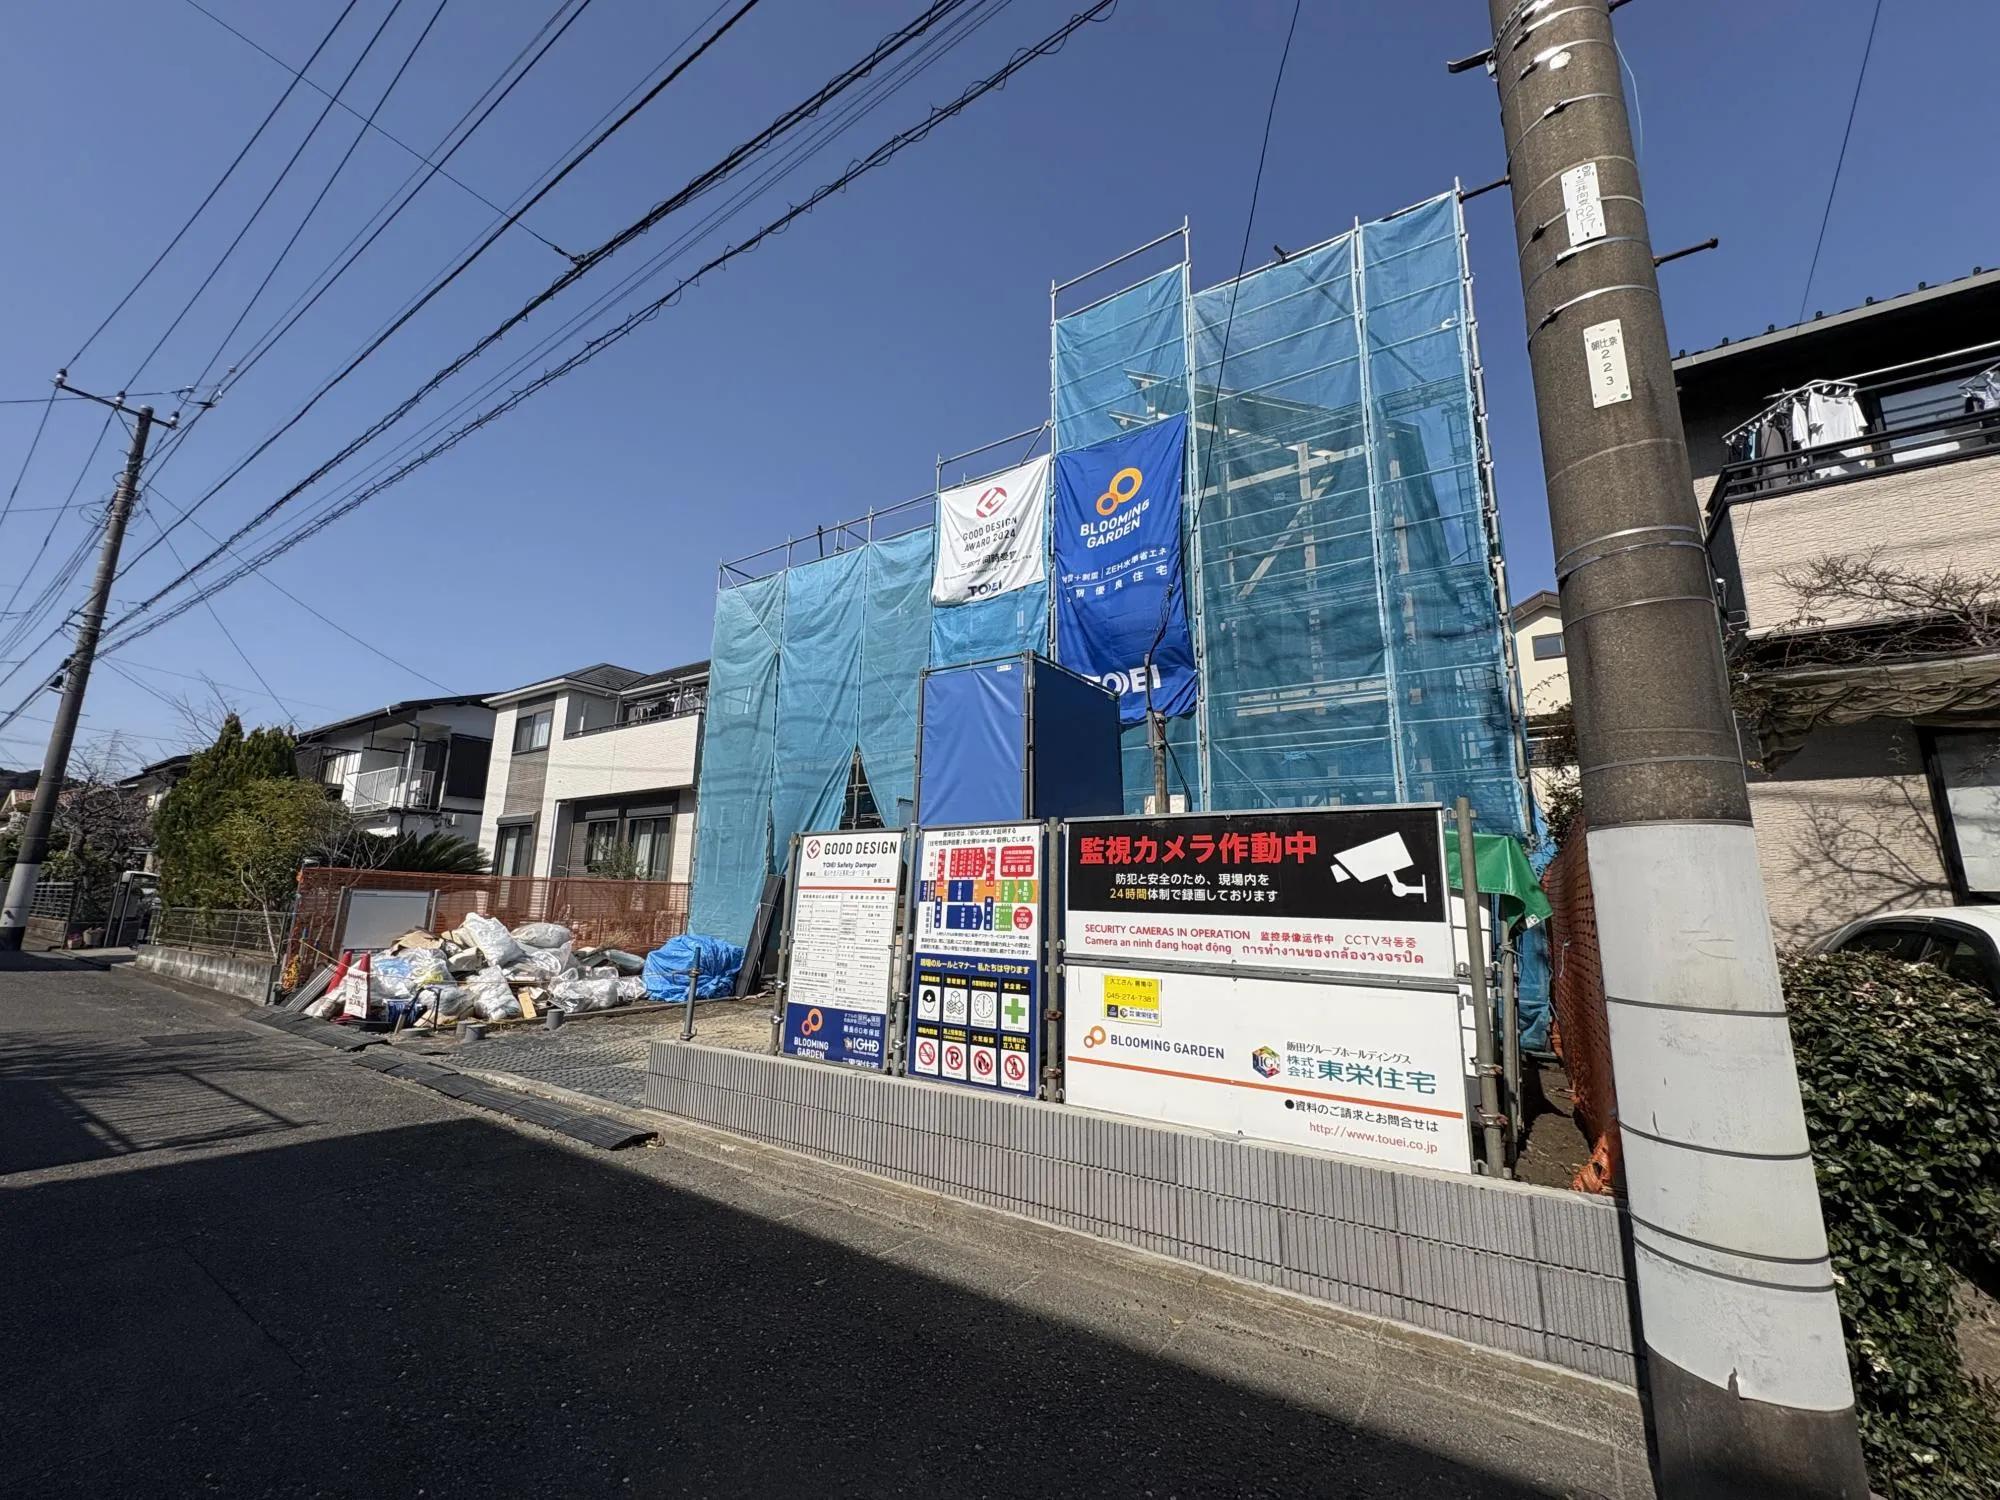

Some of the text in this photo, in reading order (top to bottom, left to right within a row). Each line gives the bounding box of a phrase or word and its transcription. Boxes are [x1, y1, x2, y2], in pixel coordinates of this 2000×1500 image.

[1080, 498, 1150, 537] BLOOMING
[962, 516, 1017, 541] GOOD DESIGN
[1086, 516, 1141, 549] GARDEN
[964, 528, 1016, 552] AWARD 2024
[824, 841, 897, 855] GOOD DESIGN
[1079, 831, 1317, 865] 監視カメラ作動中
[1115, 873, 1270, 887] 防犯と安全のため、現場内を
[1109, 888, 1278, 902] 24時間体制で録画しております
[1085, 924, 1250, 940] SECURITY CAMERAS IN OPERATION
[1260, 931, 1334, 945] 监控录像运作中
[1085, 936, 1232, 955] Camera an ninh đang hoạt động
[1242, 943, 1424, 964] การทำงานของกล้องวงจรปิด
[920, 958, 1030, 975] 現場のルールとマナー 私たちは守ります
[1110, 978, 1133, 986] 大工さん
[794, 1036, 829, 1051] BLOOMING
[1003, 1043, 1026, 1051] 立入禁止
[1110, 1034, 1225, 1060] BLOOMING GARDEN
[797, 1047, 825, 1060] GARDEN
[1286, 1040, 1412, 1065] 飯田グループホールディングス
[1287, 1054, 1315, 1068] 株式
[1287, 1066, 1315, 1080] 会社
[1316, 1059, 1437, 1095] 東栄住宅
[1309, 1122, 1438, 1154] http://www.touei.co.jp
